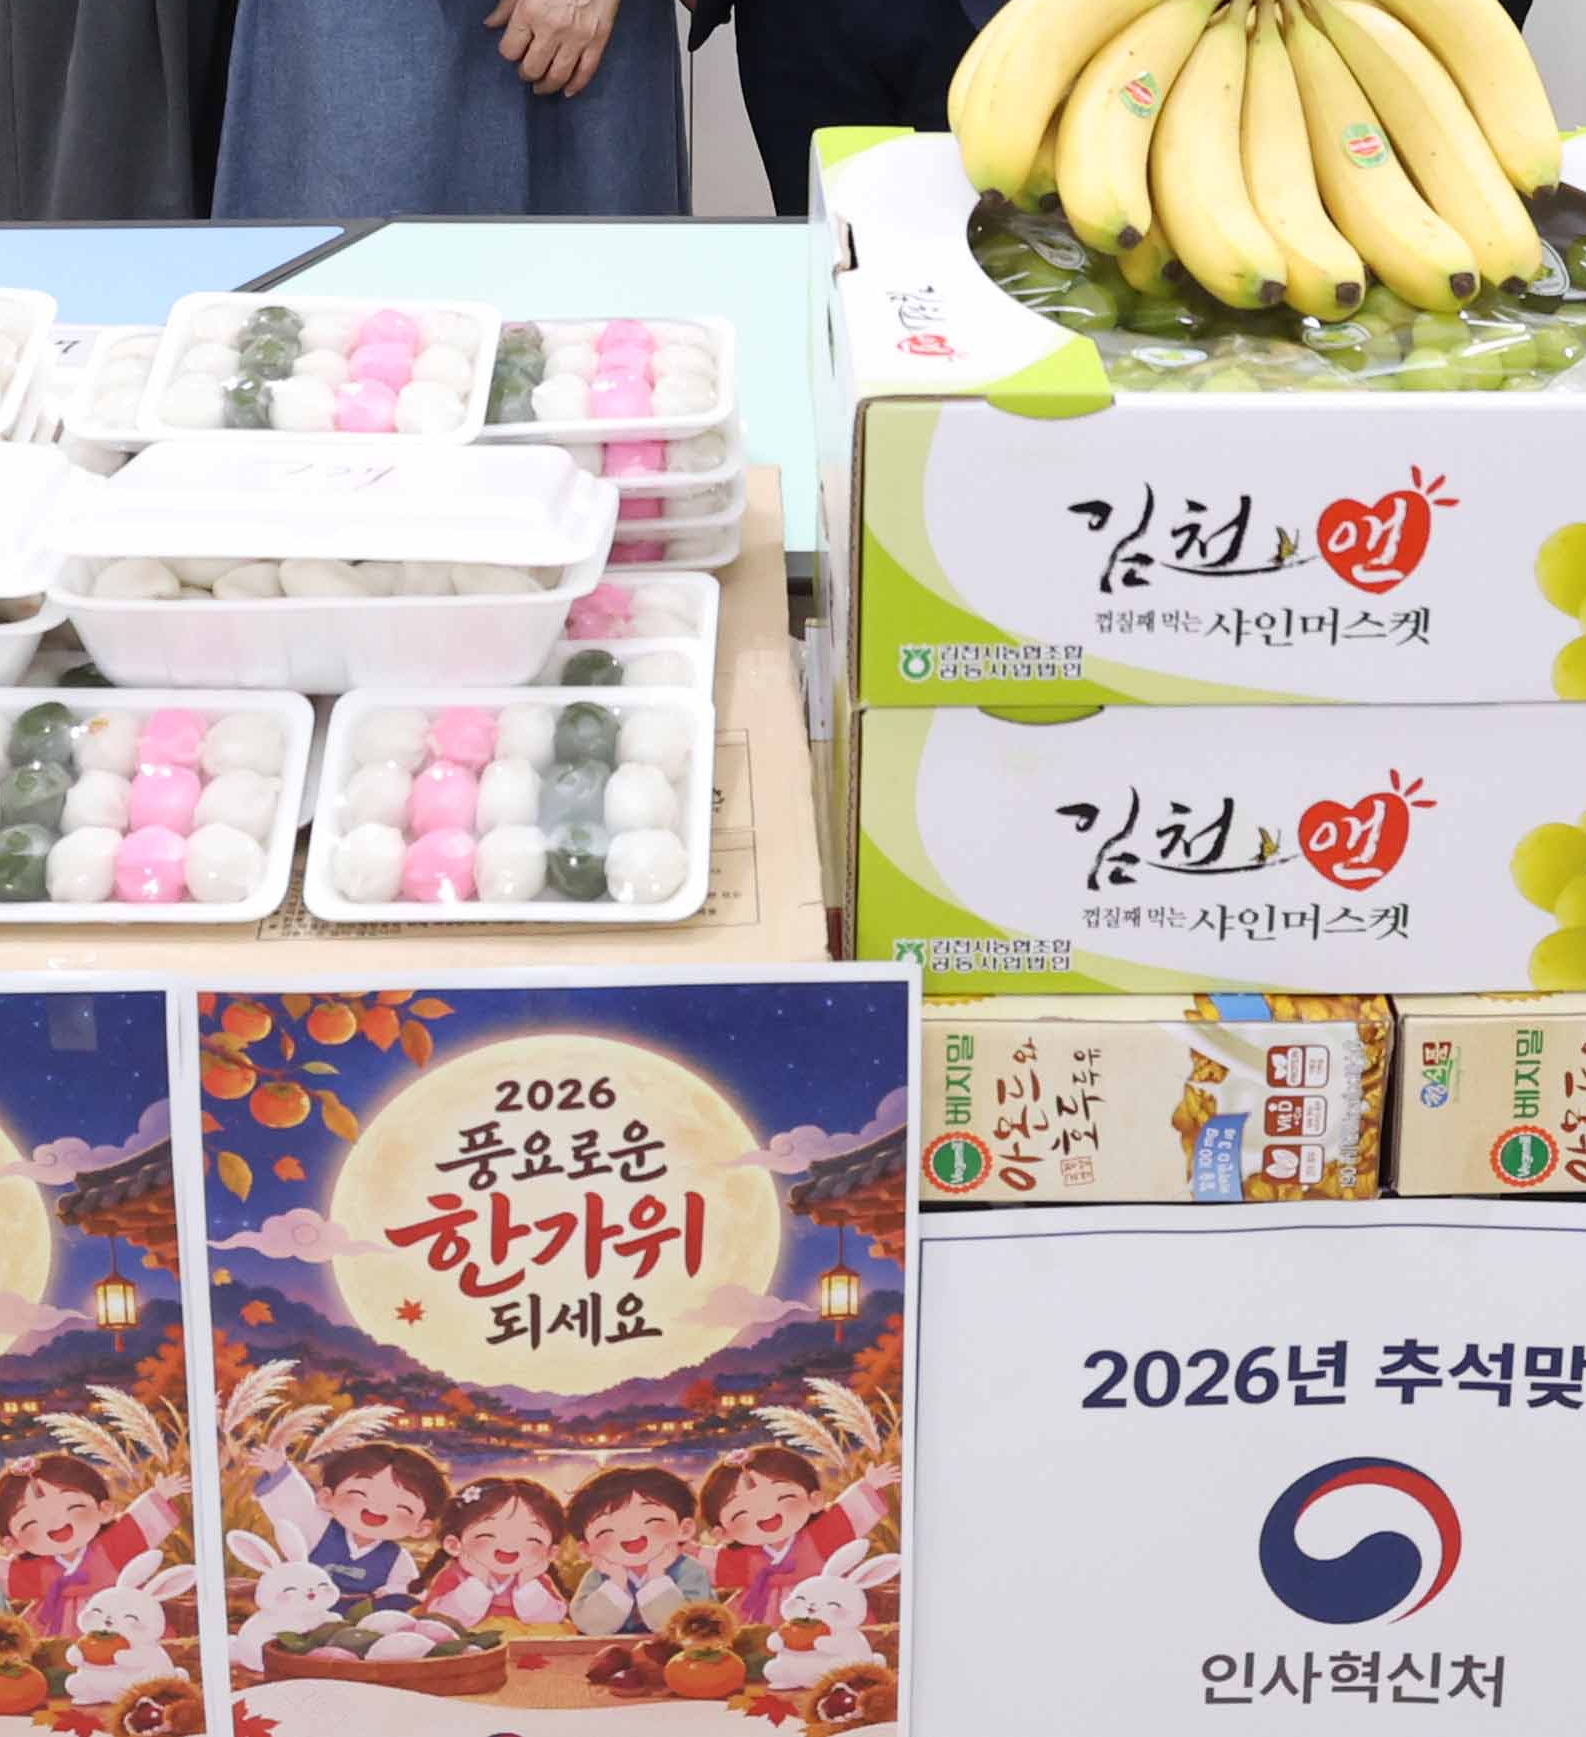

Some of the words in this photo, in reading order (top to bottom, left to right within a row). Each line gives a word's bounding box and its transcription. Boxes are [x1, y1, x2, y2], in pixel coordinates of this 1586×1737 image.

[1067, 482, 1254, 594] 김천
[1328, 497, 1407, 583] 앤
[1095, 609, 1155, 634] 껍질째
[1162, 609, 1204, 633] 먹는
[1205, 606, 1430, 647] 샤인머스켓
[1056, 785, 1234, 890] 김천
[1309, 799, 1386, 881] 앤
[1082, 906, 1142, 929] 껍질째
[1147, 906, 1188, 929] 먹는
[1189, 902, 1410, 942] 샤인머스켓
[494, 1076, 618, 1112] 2026
[945, 1034, 975, 1126] 베지밀
[1514, 1028, 1544, 1120] 베지밀
[994, 1036, 1050, 1191] 아몬드와
[435, 1119, 670, 1191] 풍요로운
[383, 1190, 705, 1299] 한가위
[485, 1292, 665, 1351] 되세요
[1081, 1339, 1351, 1410] 2026년
[1200, 1649, 1508, 1709] 인사혁신처
